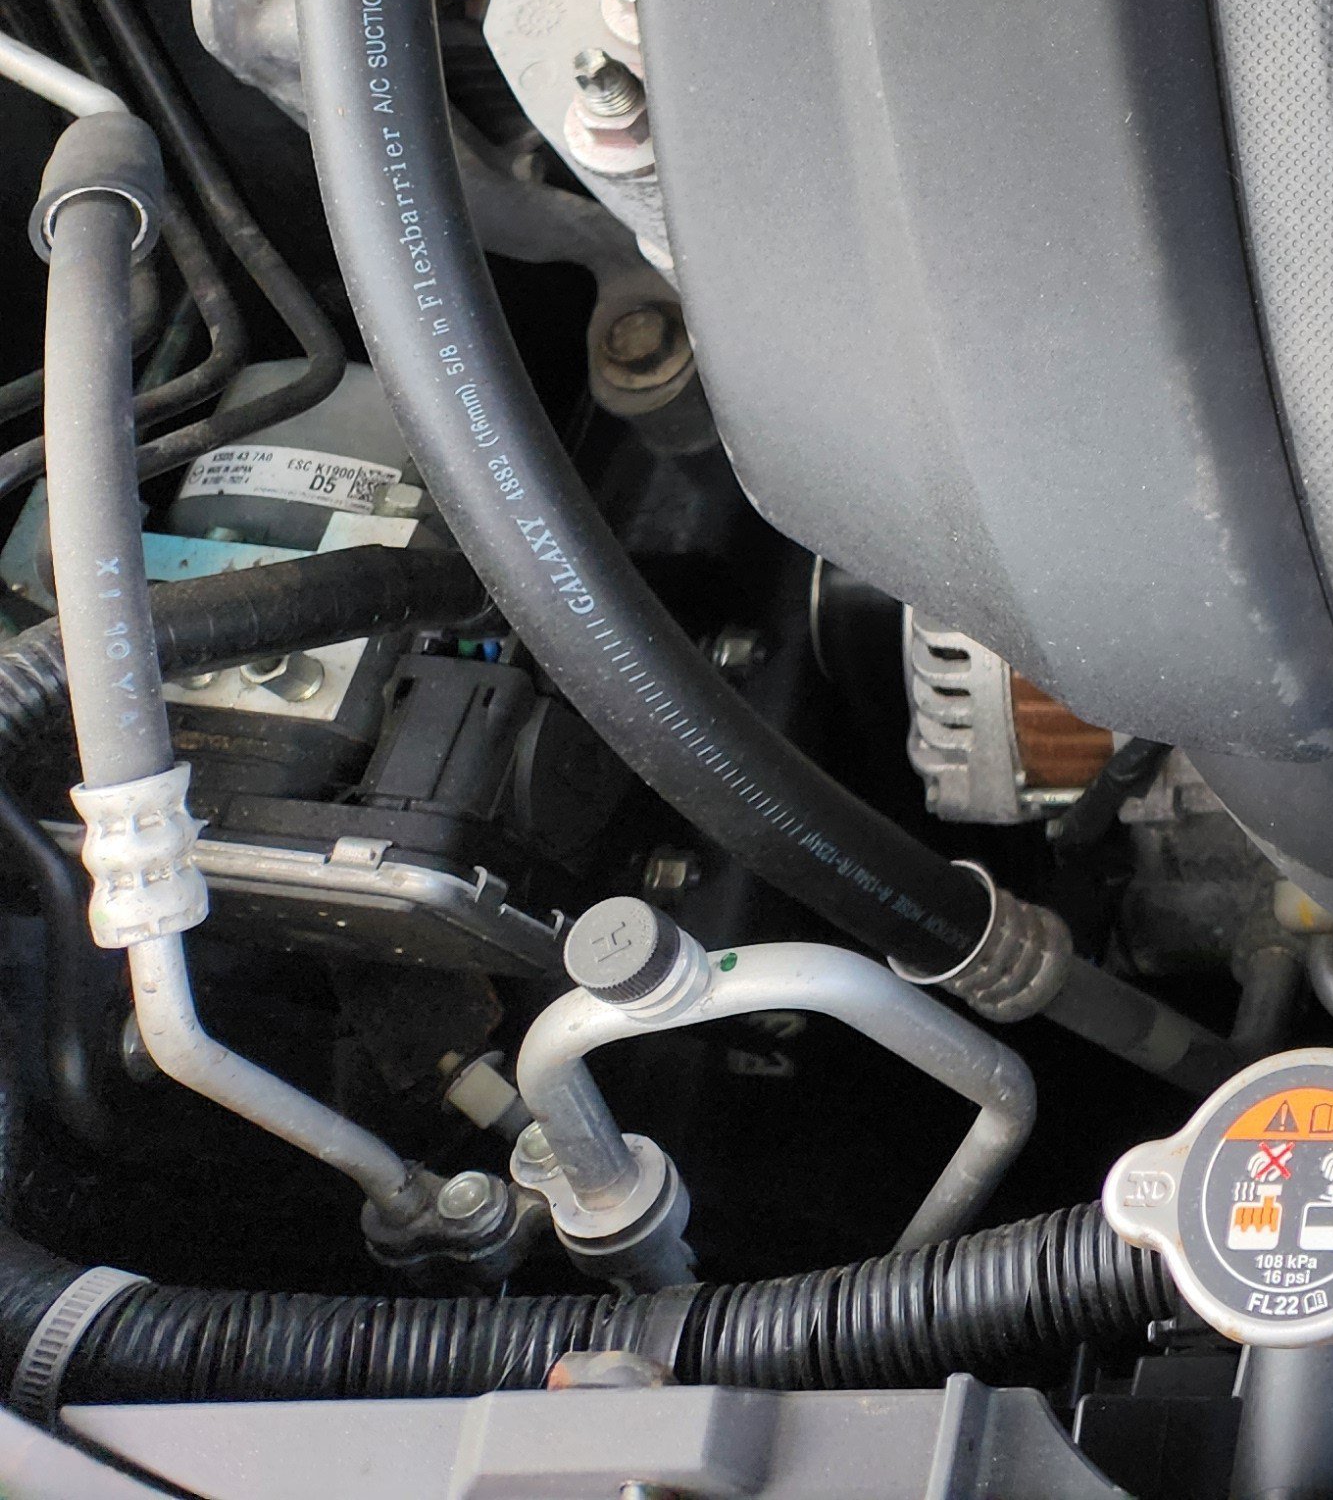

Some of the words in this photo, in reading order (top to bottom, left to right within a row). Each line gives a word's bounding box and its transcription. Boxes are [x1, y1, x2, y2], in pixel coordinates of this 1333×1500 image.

[370, 78, 394, 114] A/C
[383, 127, 444, 313] Flexbarrier
[432, 318, 450, 337] in
[439, 344, 465, 376] 5/8
[309, 474, 337, 494] D5
[516, 516, 596, 615] GALAXY
[1255, 1255, 1284, 1269] 108
[1286, 1254, 1318, 1269] kPa
[1263, 1270, 1281, 1284] 16
[1285, 1270, 1311, 1287] psi
[1247, 1292, 1299, 1315] FL22
